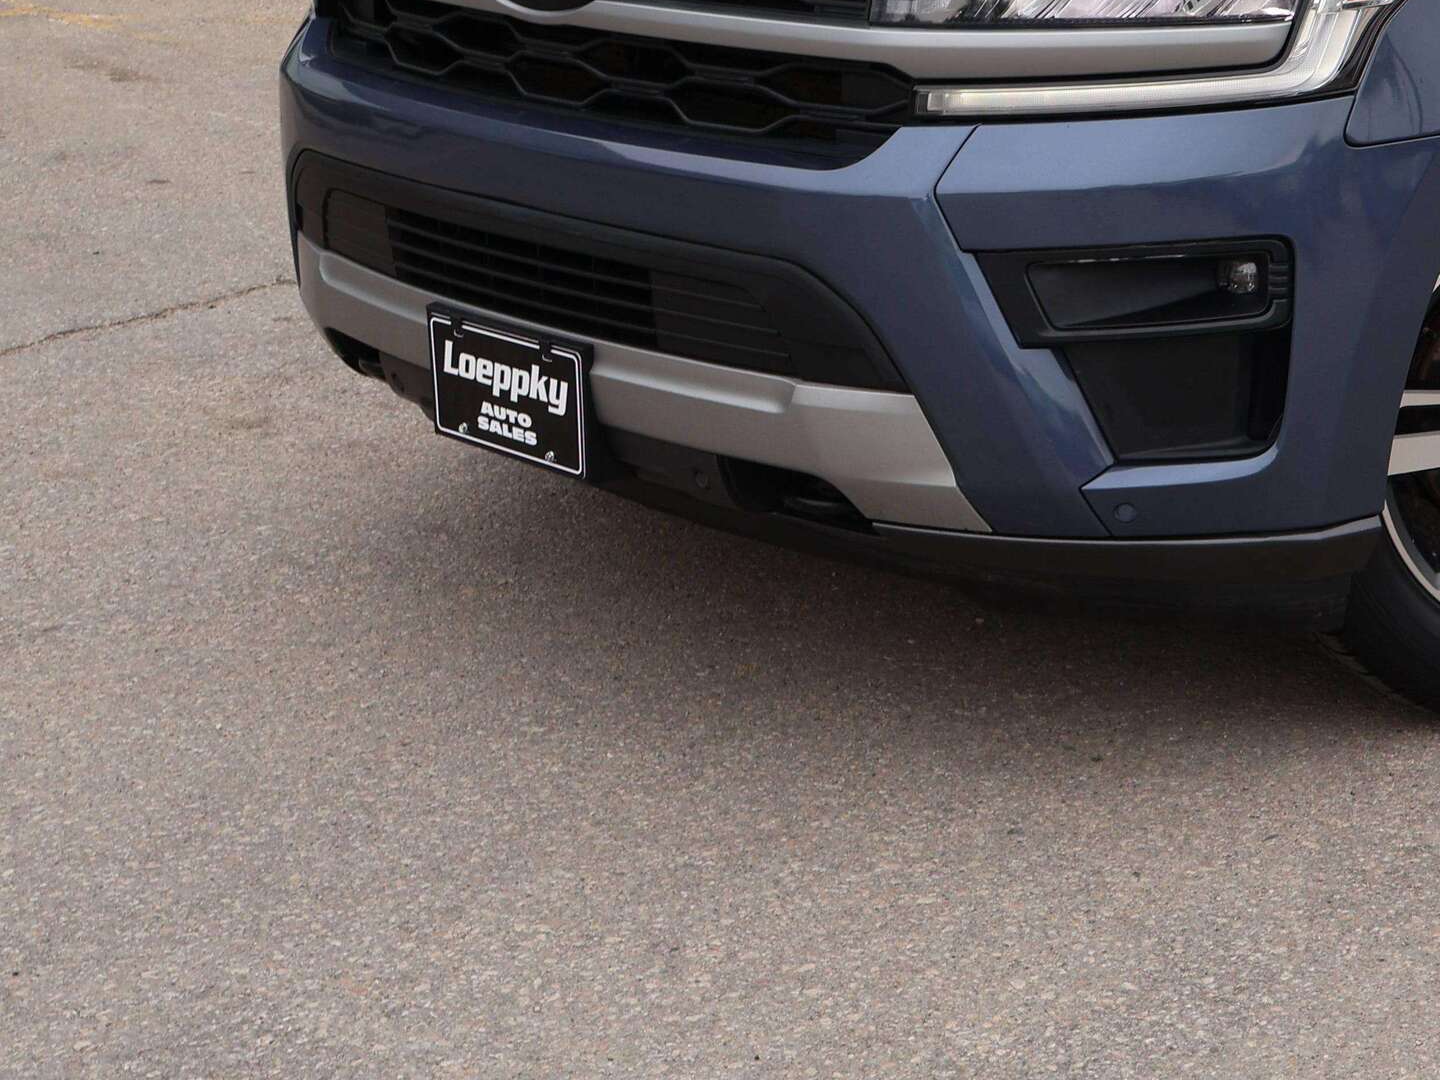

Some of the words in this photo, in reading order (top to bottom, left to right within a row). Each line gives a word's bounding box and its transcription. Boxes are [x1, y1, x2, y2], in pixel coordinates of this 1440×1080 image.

[443, 340, 568, 417] Loeppky
[480, 401, 532, 428] AUTO
[477, 416, 538, 446] SALES
